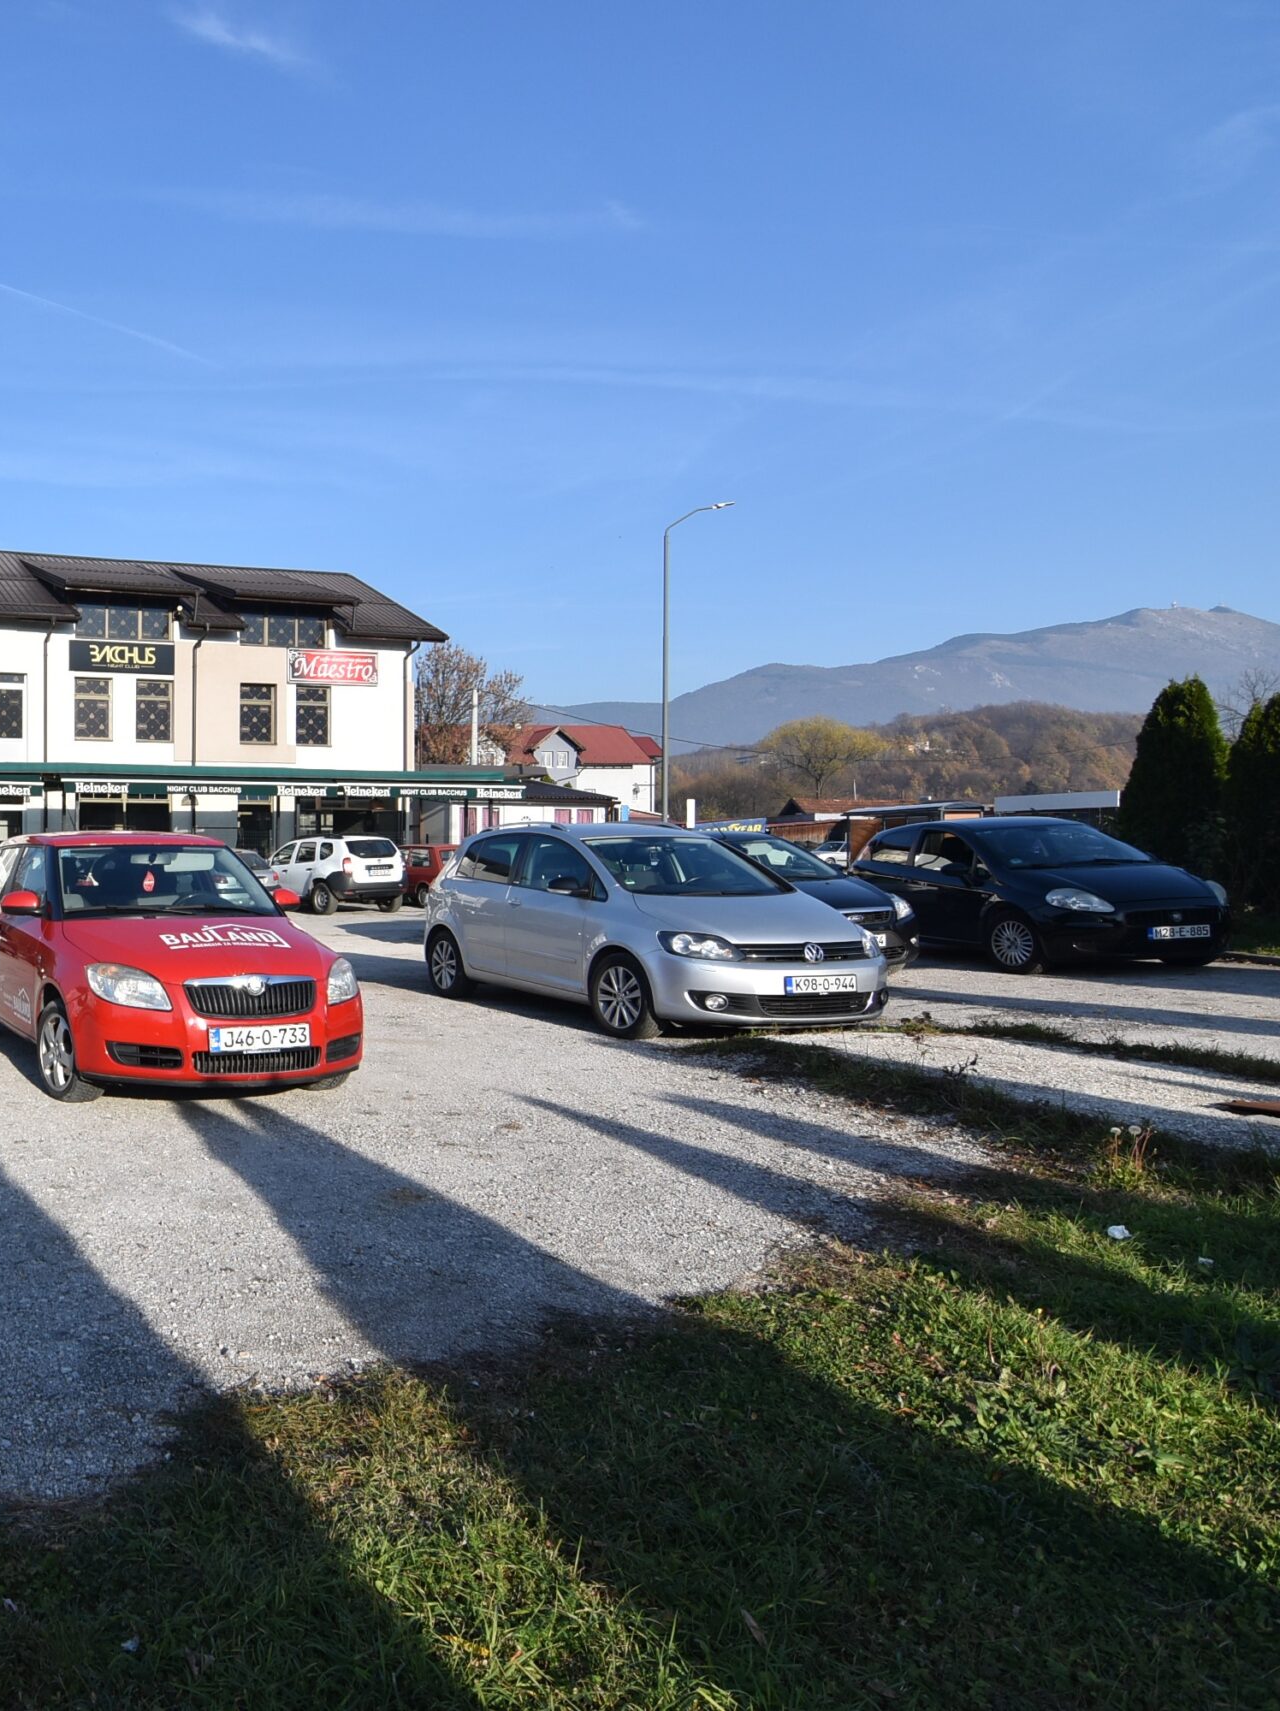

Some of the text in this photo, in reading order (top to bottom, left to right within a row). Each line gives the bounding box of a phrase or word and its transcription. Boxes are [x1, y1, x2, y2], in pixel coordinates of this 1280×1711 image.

[89, 644, 157, 665] BACCHUS
[294, 655, 373, 681] Maestro
[75, 782, 129, 794] Heineken
[167, 785, 187, 793] NIGHT
[208, 786, 241, 794] BACCHUS
[277, 785, 327, 797] Heineken
[400, 788, 419, 796] NIGHT
[420, 788, 437, 796] CLUB
[438, 789, 467, 797] BACCHUS
[476, 788, 523, 799] Heineken
[159, 926, 278, 945] BAULAND
